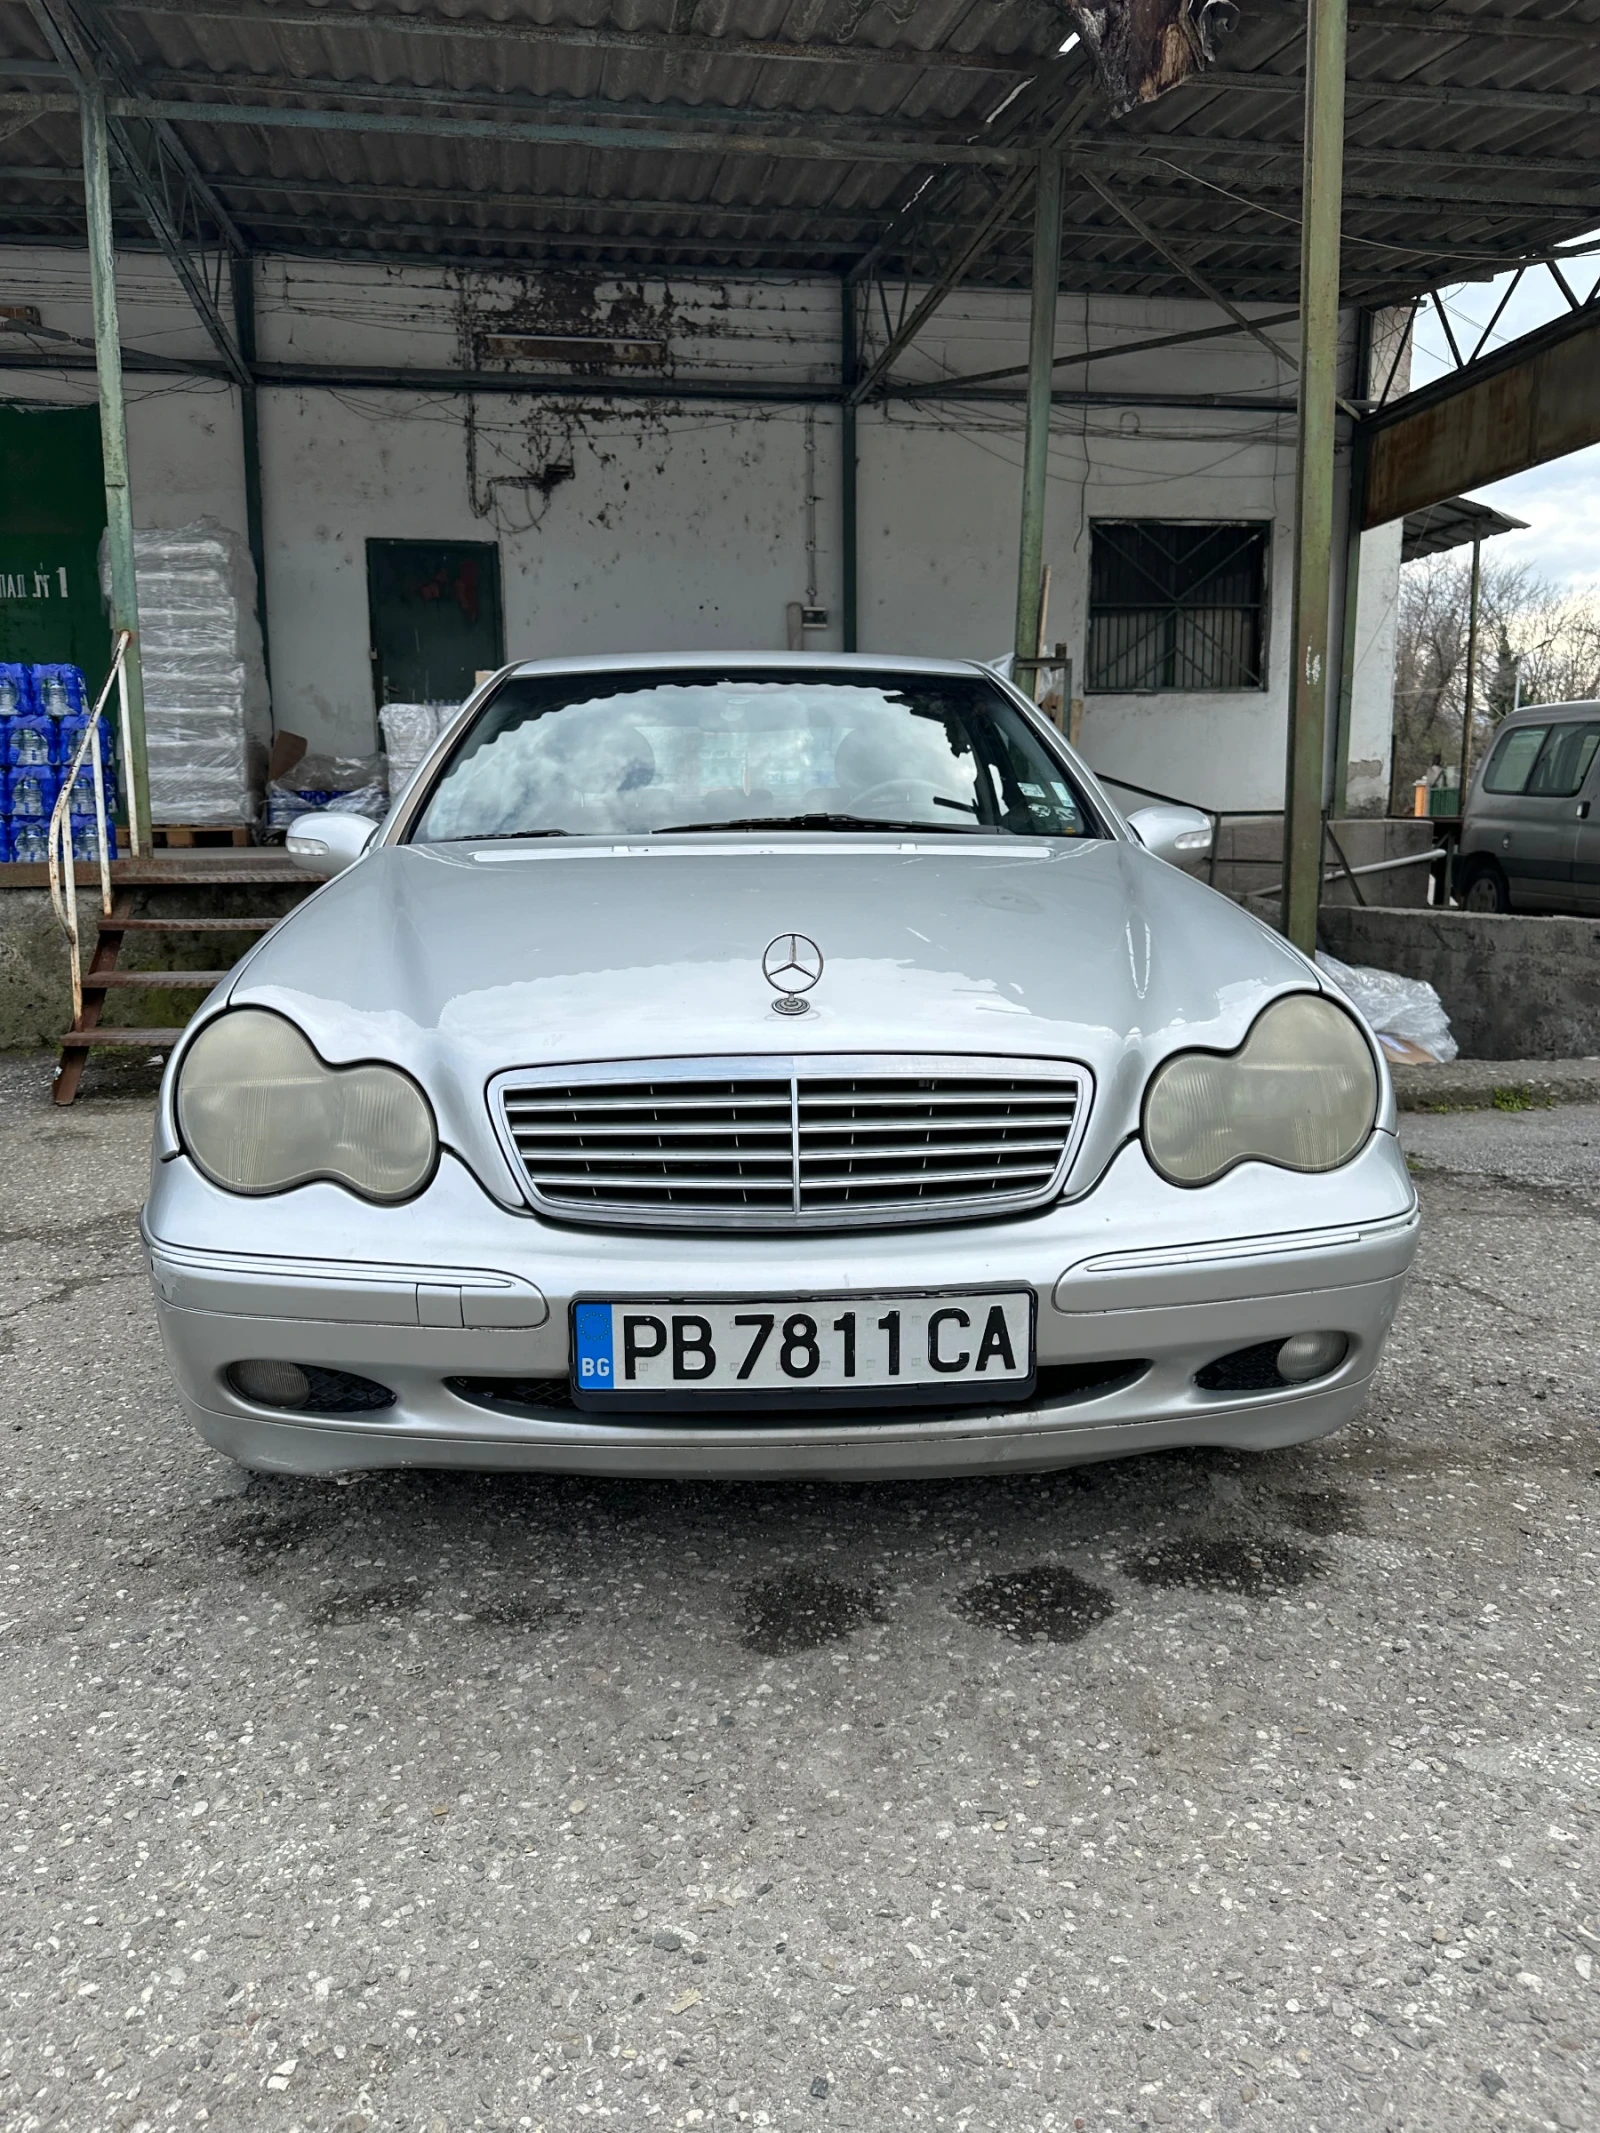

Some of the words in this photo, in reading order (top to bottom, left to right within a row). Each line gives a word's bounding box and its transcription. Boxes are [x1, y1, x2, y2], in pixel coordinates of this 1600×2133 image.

[56, 567, 68, 598] 1
[734, 1310, 900, 1380] 7811
[581, 1357, 610, 1377] BG
